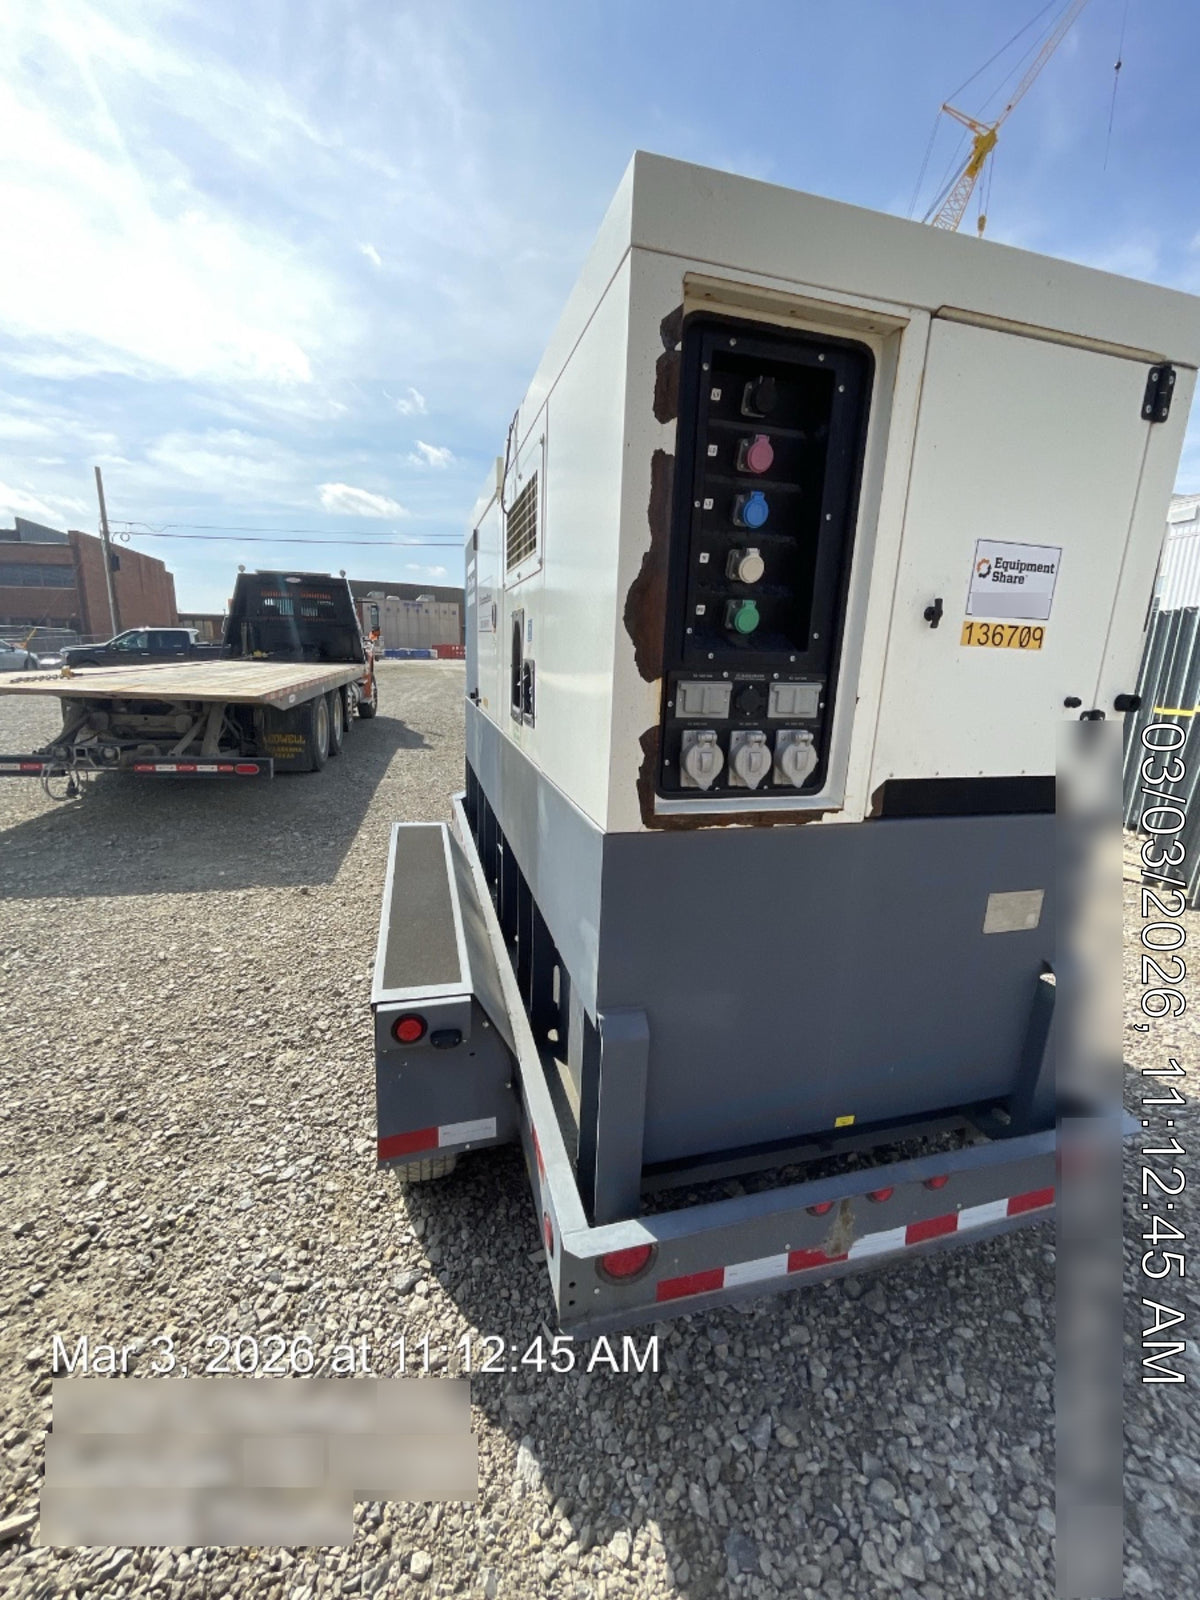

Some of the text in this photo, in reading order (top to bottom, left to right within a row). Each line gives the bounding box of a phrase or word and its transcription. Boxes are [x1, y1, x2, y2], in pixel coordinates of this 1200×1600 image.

[994, 557, 1055, 574] Equipment
[992, 571, 1025, 585] Share
[965, 622, 1045, 649] 136709
